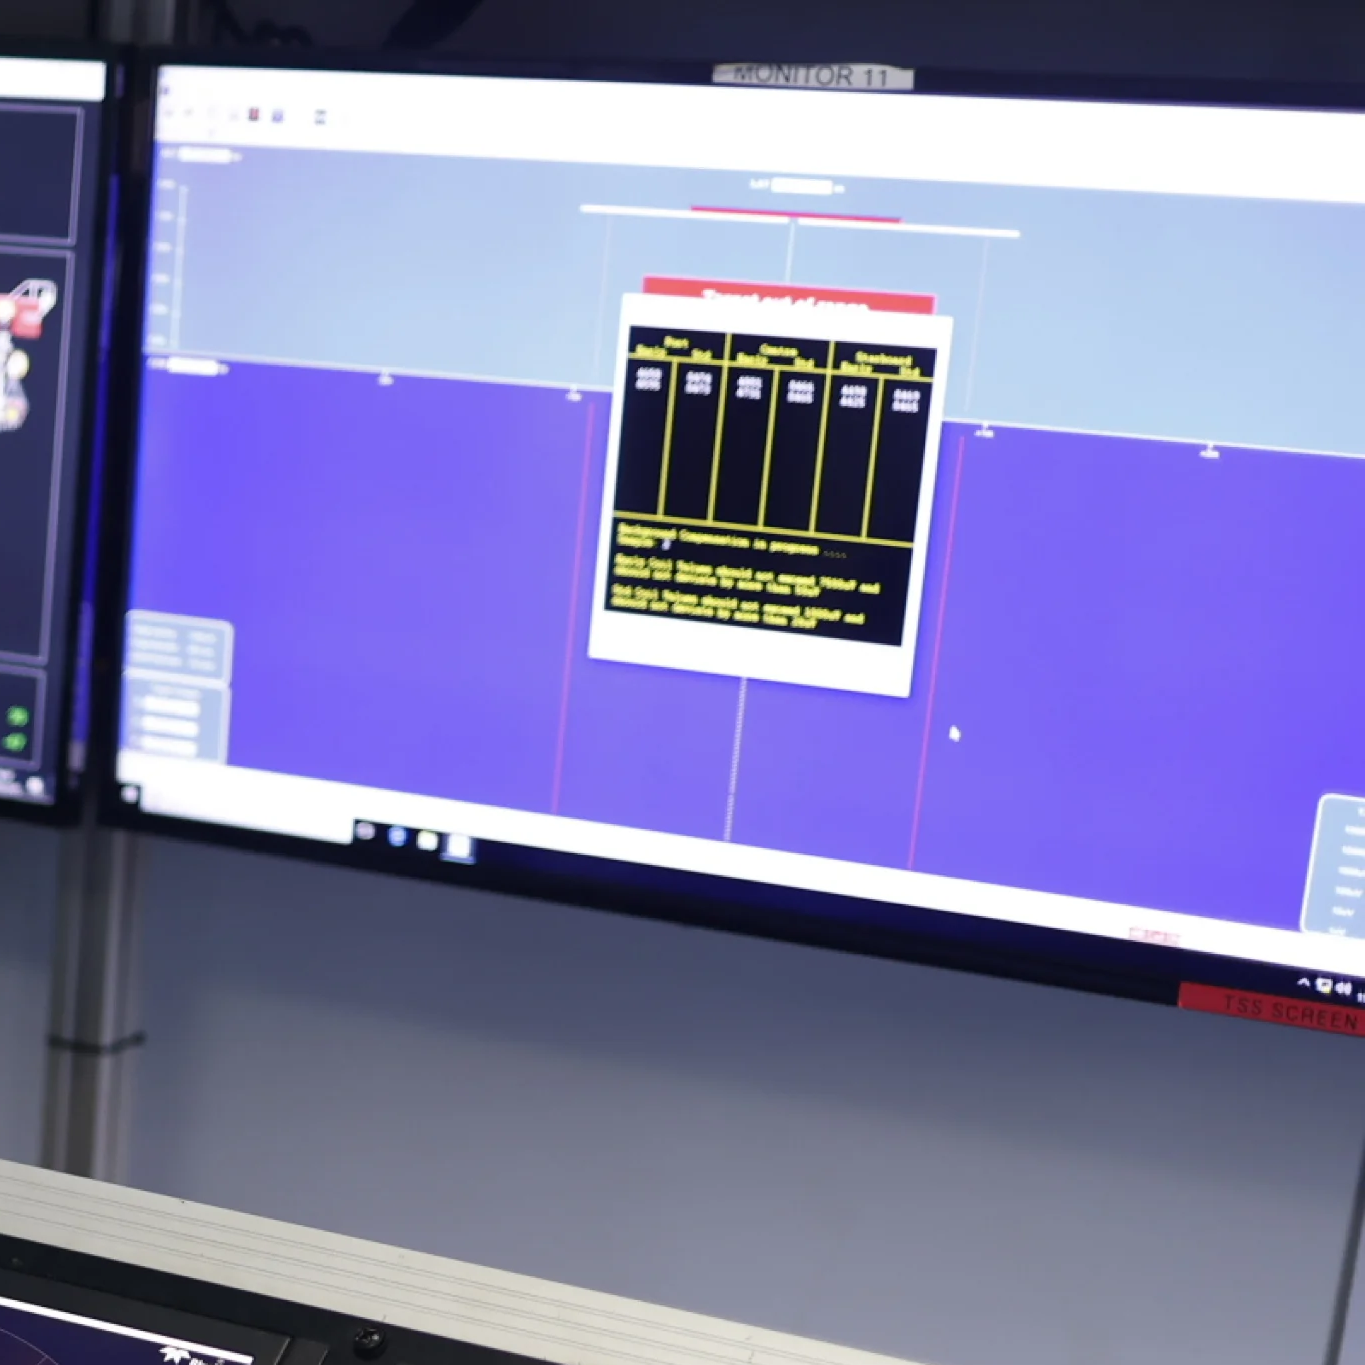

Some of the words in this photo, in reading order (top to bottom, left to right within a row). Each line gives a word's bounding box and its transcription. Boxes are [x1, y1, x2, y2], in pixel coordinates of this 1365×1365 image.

[863, 67, 889, 88] 11
[1224, 994, 1263, 1016] TSS
[1272, 1001, 1359, 1032] SCREEN
